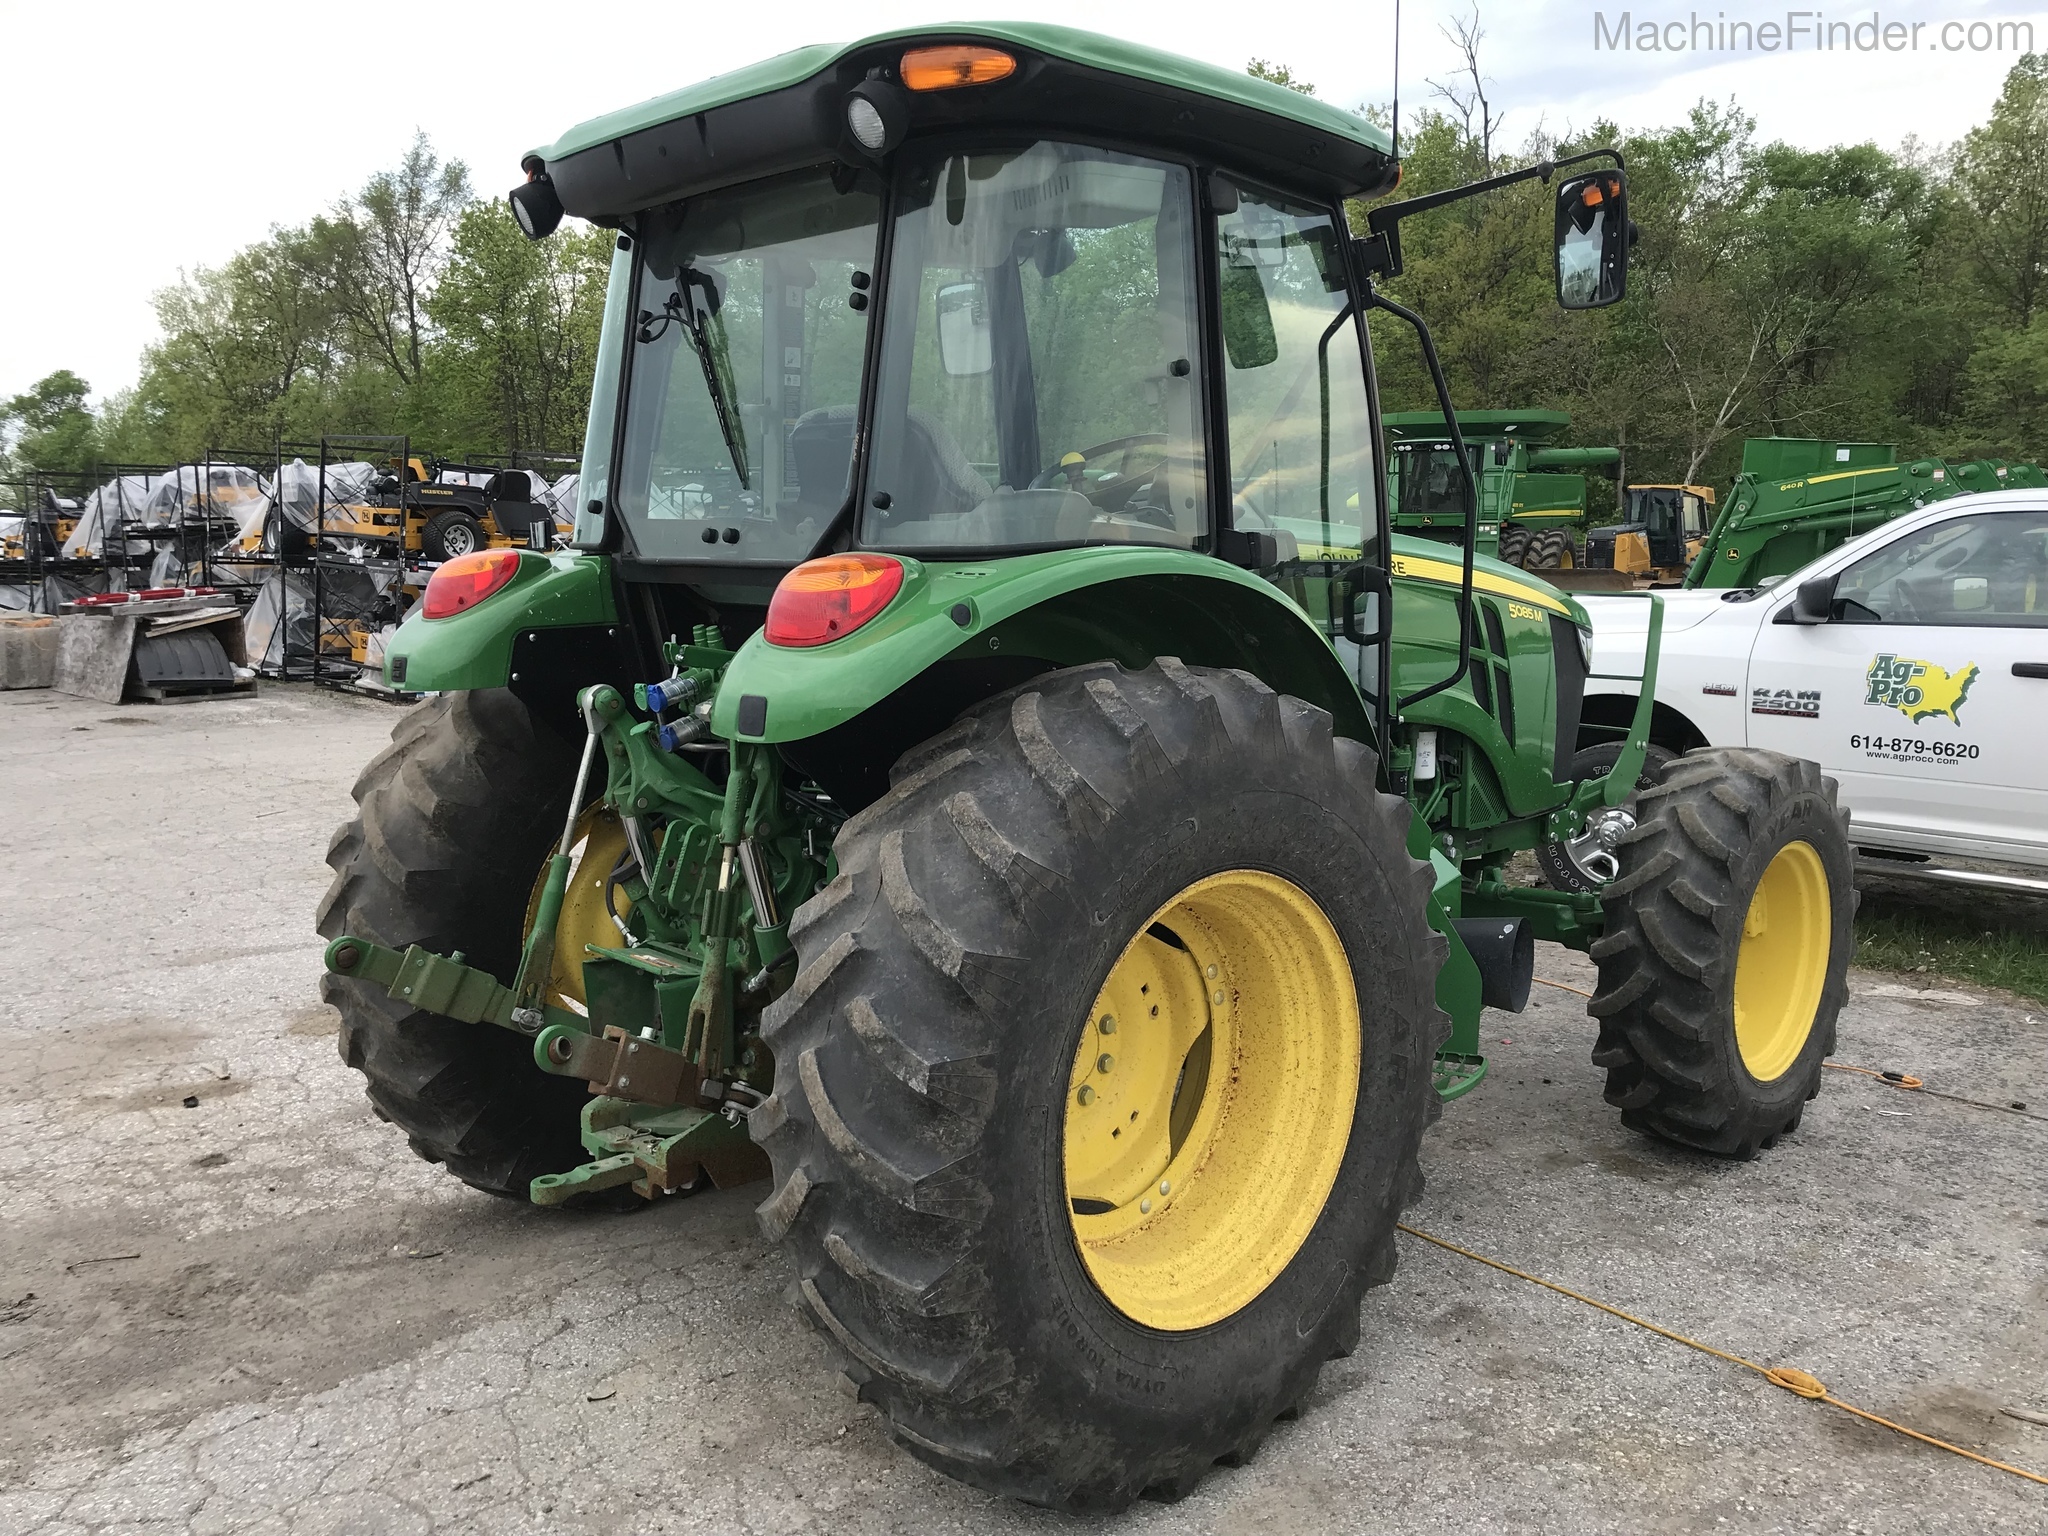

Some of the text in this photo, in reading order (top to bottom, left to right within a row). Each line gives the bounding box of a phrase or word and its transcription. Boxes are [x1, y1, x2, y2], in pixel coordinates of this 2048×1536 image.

[1752, 687, 1822, 701] RAM
[1864, 679, 1924, 707] Pro
[1751, 698, 1820, 712] 2500
[1850, 734, 1980, 759] 614-879-6620
